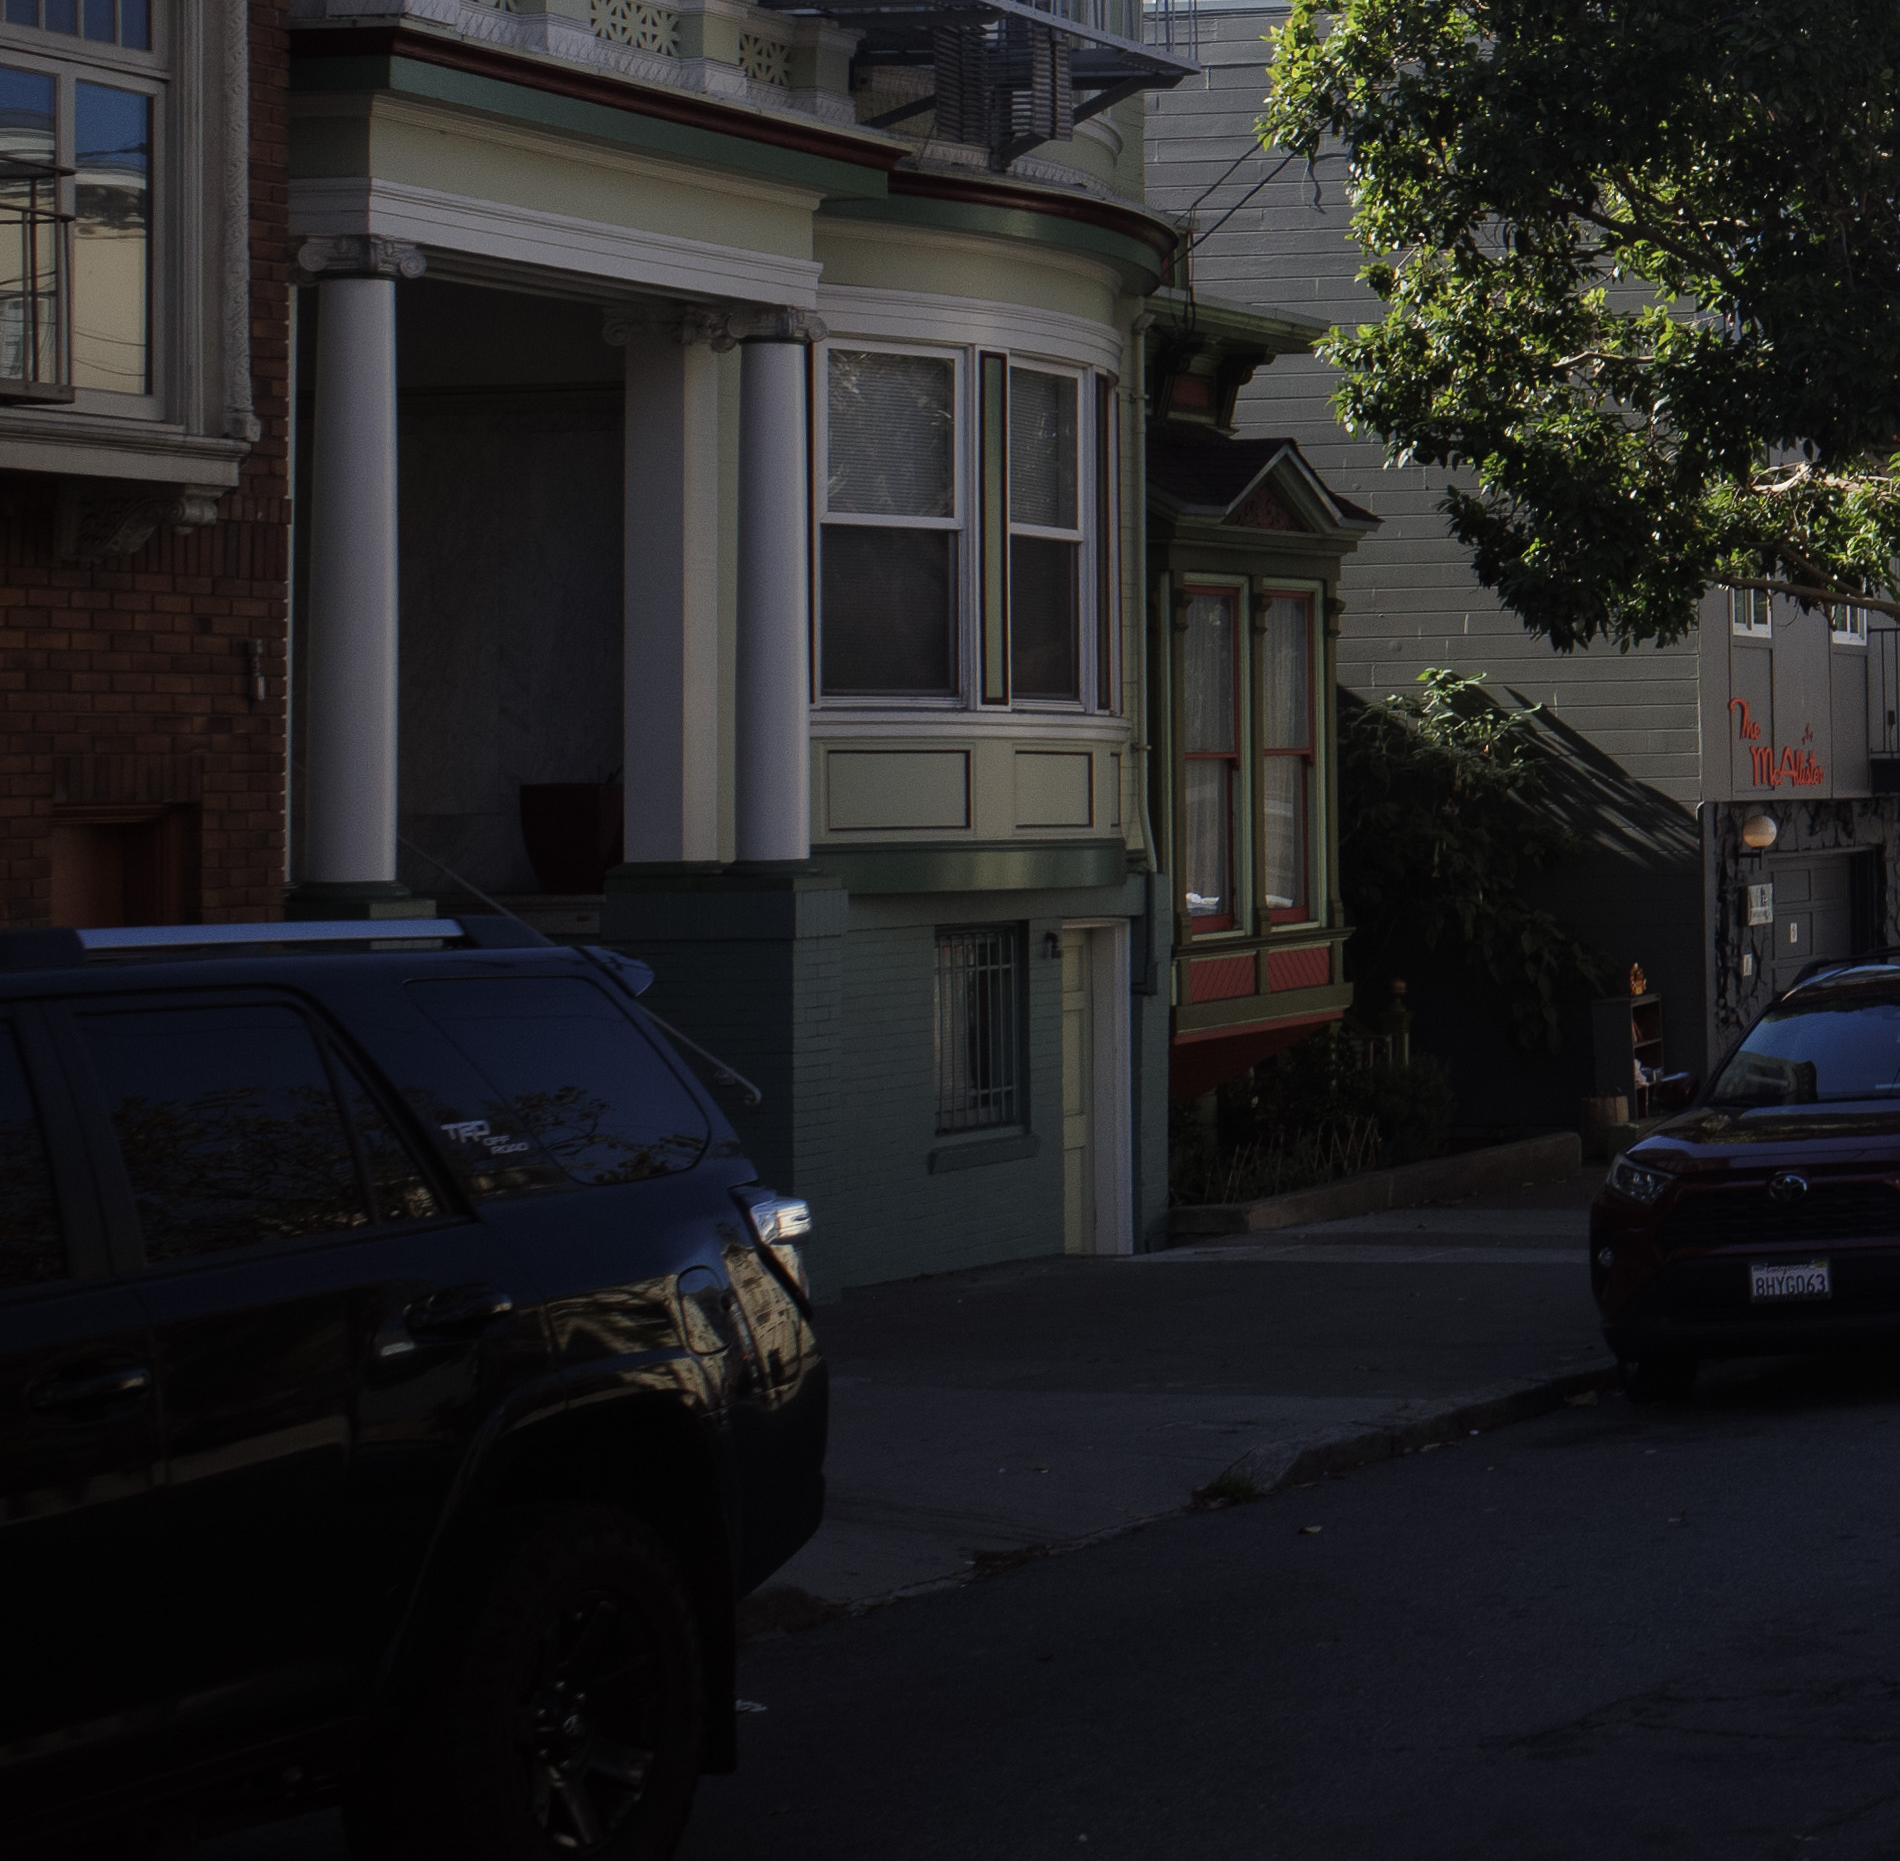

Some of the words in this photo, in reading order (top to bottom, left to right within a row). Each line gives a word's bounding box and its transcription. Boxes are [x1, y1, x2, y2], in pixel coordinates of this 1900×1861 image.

[1728, 697, 1761, 740] The
[440, 1119, 491, 1143] TRD
[482, 1134, 511, 1146] OFF
[490, 1141, 530, 1155] ROAD
[1755, 1273, 1826, 1296] 8HYG063
